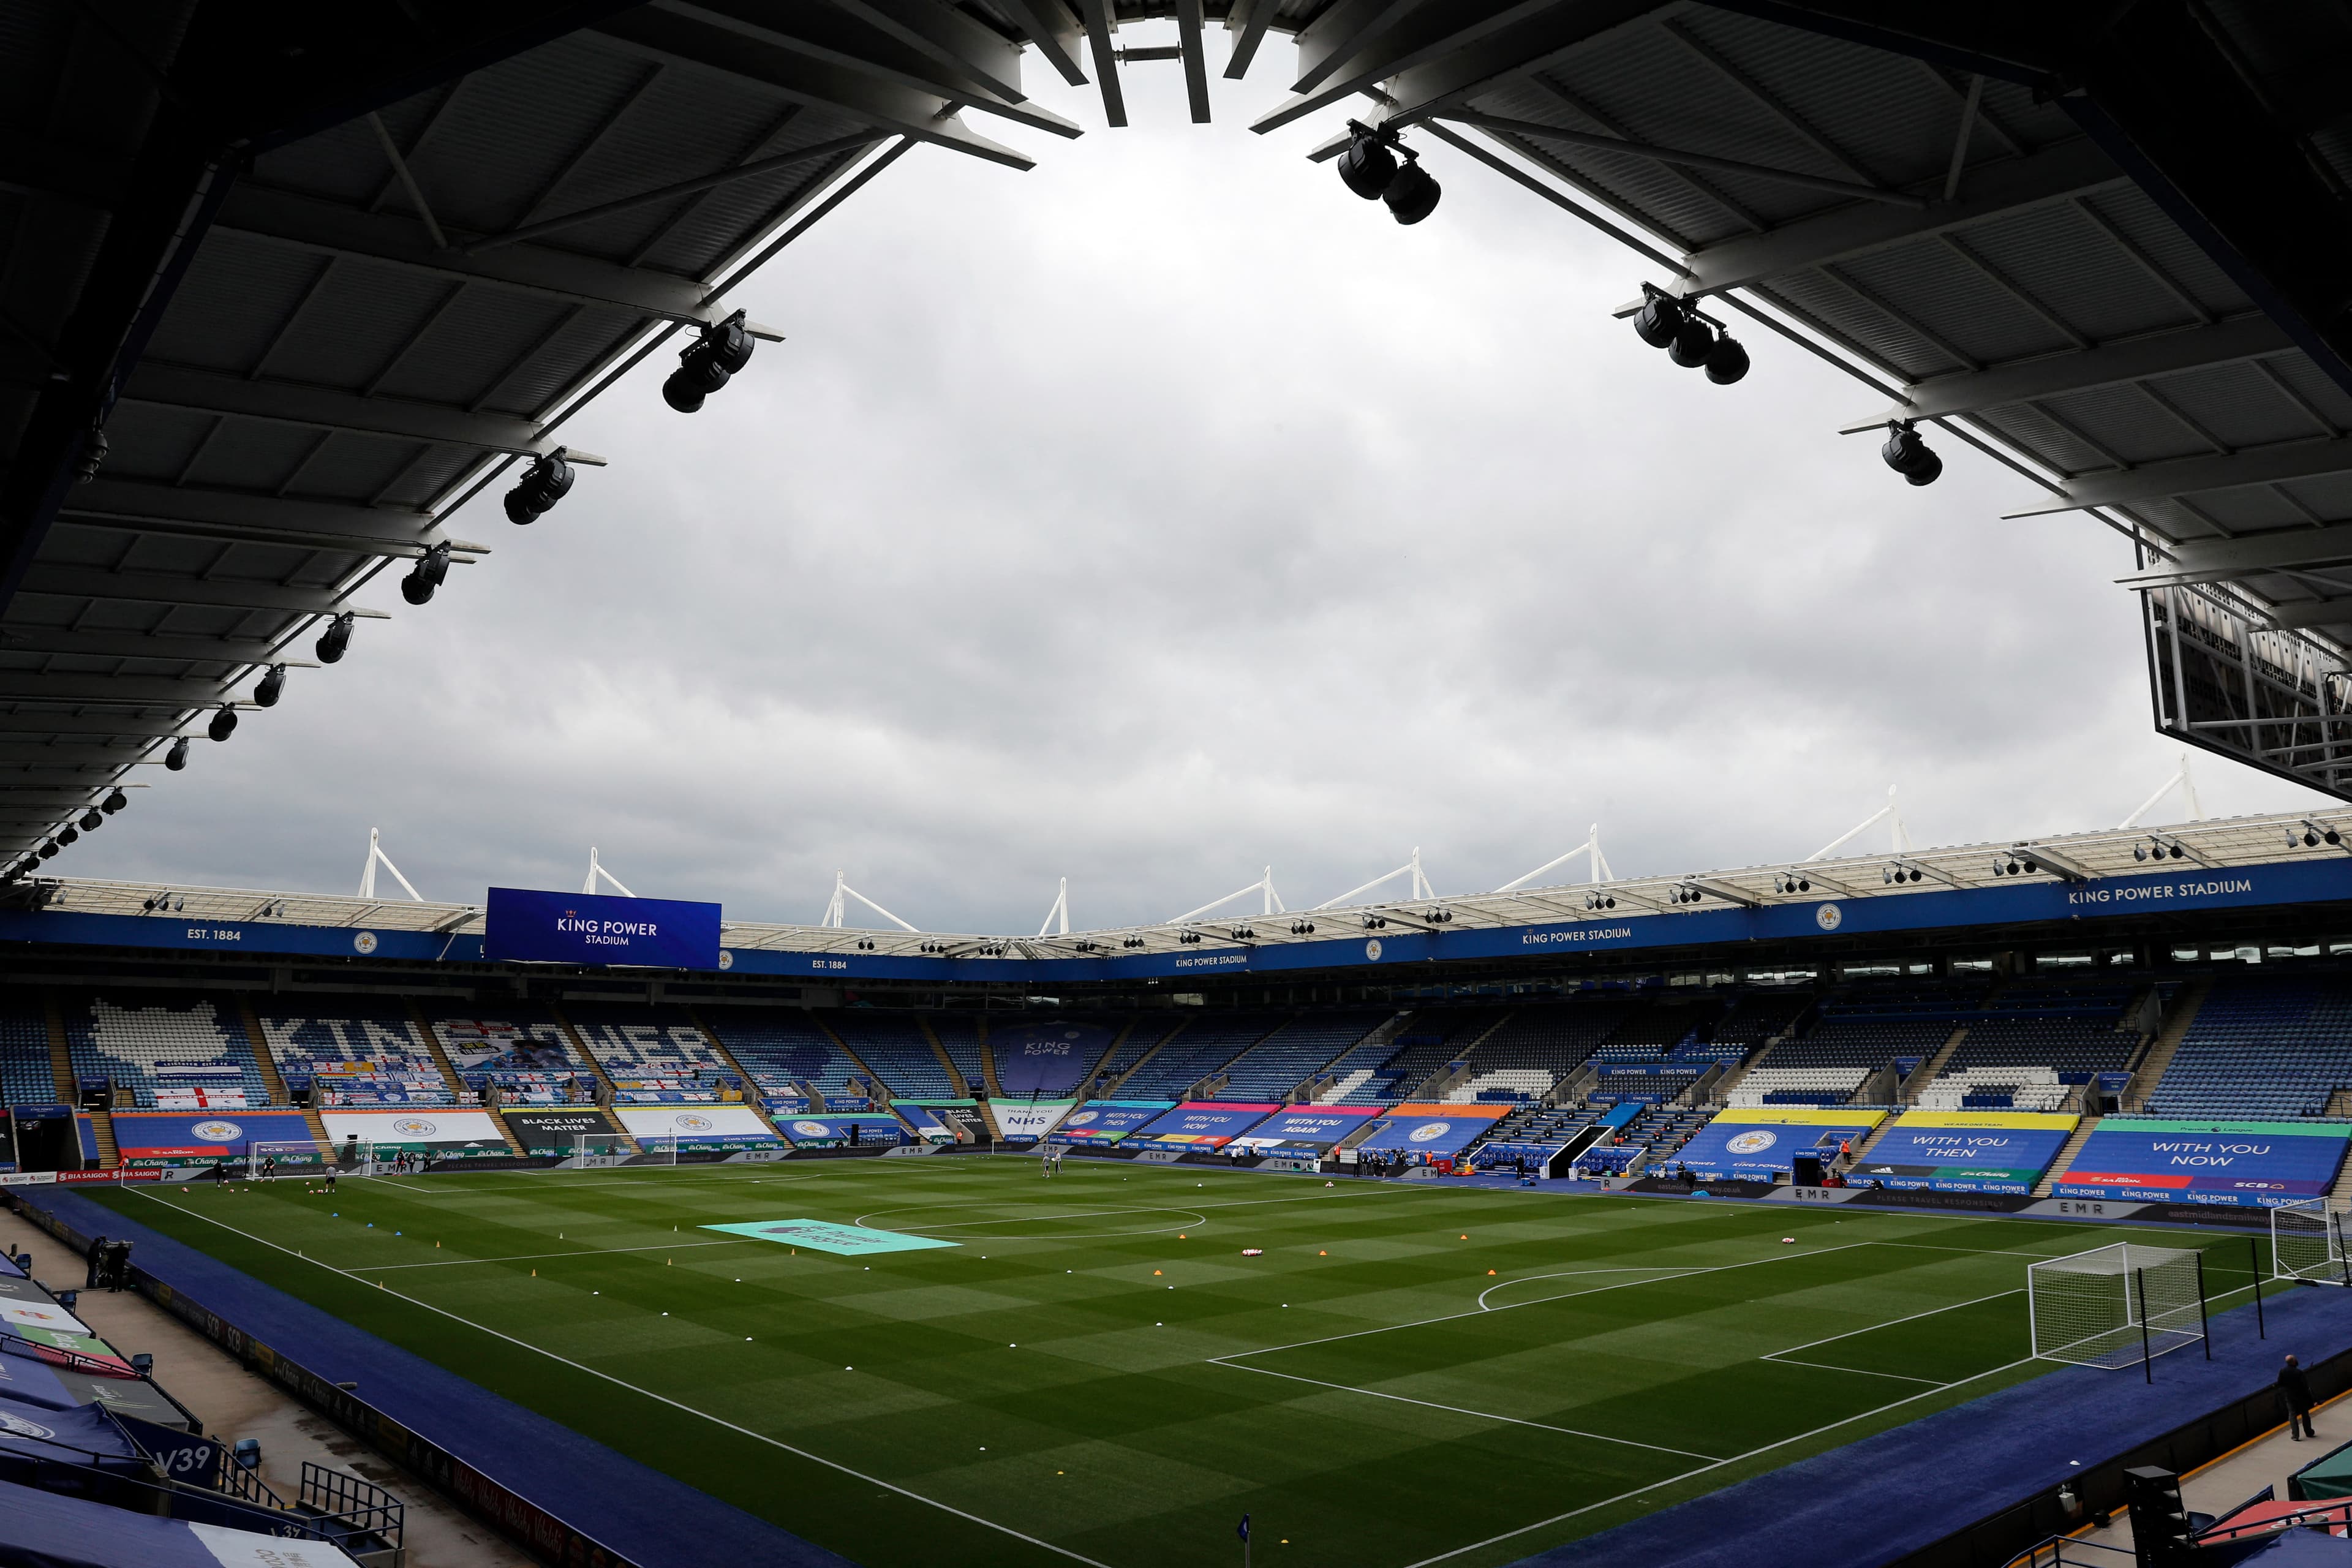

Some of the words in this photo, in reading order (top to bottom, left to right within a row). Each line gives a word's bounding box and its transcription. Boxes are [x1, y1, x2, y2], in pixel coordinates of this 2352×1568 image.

[2068, 889, 2109, 904] KING
[2116, 886, 2174, 900] POWER
[2179, 880, 2252, 897] STADIUM
[557, 919, 598, 933] KING
[603, 921, 657, 936] POWER
[187, 929, 209, 940] EST.
[214, 930, 241, 941] 1884
[585, 935, 628, 946] STADIUM
[1523, 934, 1548, 944] KING
[1551, 932, 1585, 942] POWER
[1588, 927, 1630, 940] STADIUM
[1194, 957, 1218, 966] POWER
[1219, 956, 1247, 964] STADIUM
[1026, 1041, 1071, 1050] KING
[1913, 1136, 1962, 1146] WITH
[1967, 1138, 2009, 1147] YOU
[1926, 1148, 1977, 1158] THEN
[2152, 1142, 2212, 1153] WITH
[2219, 1144, 2271, 1155] YOU
[2170, 1156, 2234, 1166] NOW
[1657, 1183, 1741, 1193] eastmidladsrailway.co.uk
[1795, 1189, 1829, 1199] EMR
[1945, 1198, 2003, 1207] RESPONSIBLY
[2060, 1202, 2103, 1214] EMR
[207, 1314, 219, 1340] SCB
[227, 1326, 241, 1353] SCB
[282, 1361, 299, 1394] Chang
[156, 1446, 211, 1472] V39
